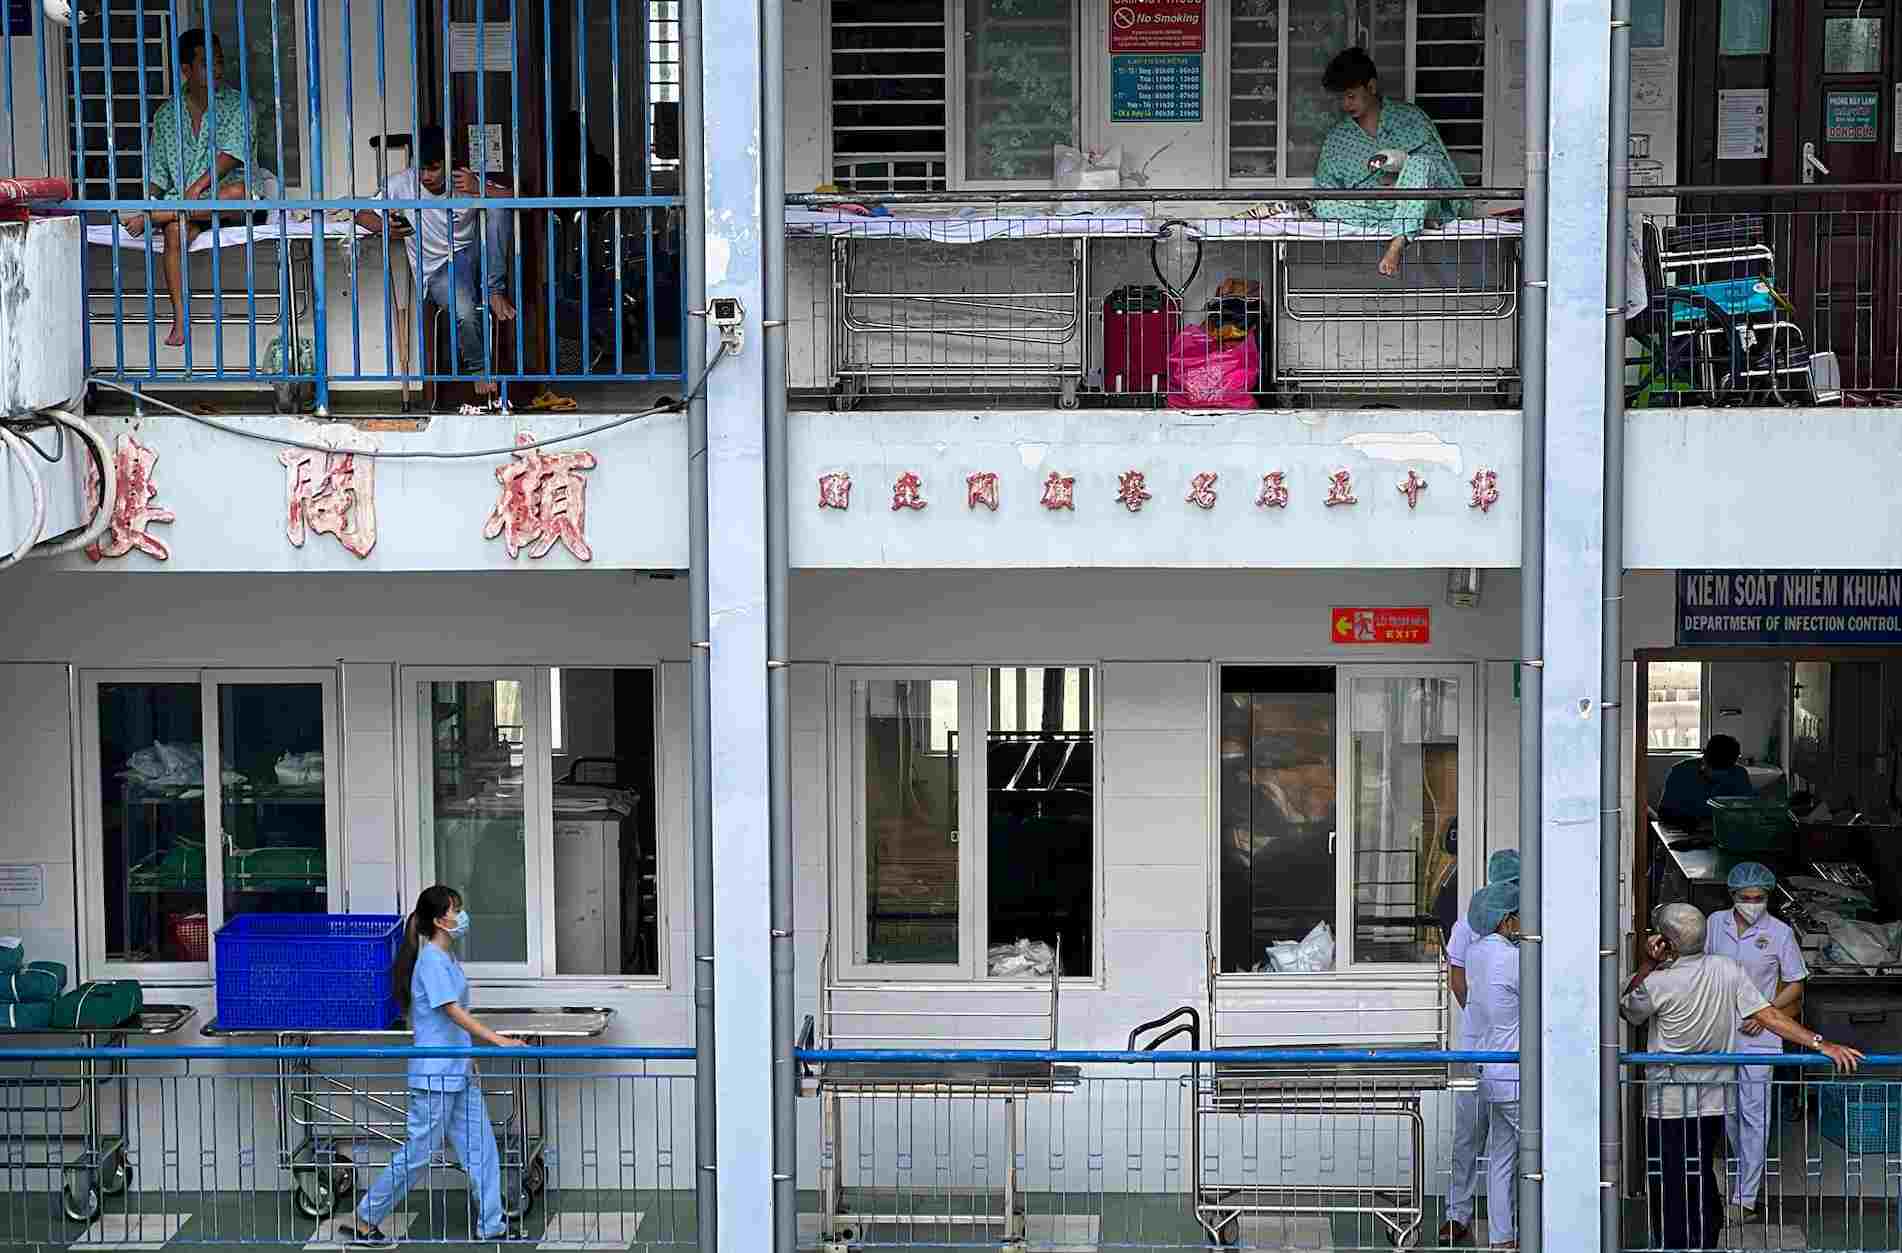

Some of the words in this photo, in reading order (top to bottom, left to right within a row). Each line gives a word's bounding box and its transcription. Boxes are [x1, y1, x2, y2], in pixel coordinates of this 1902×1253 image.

[1137, 14, 1151, 23] No
[1153, 14, 1199, 24] Smoking
[1685, 615, 1761, 632] DEPARTMENT
[1766, 615, 1781, 632] OF
[1784, 615, 1844, 632] INFECTION
[1847, 615, 1901, 632] CONTROL
[1384, 630, 1419, 639] EXIT
